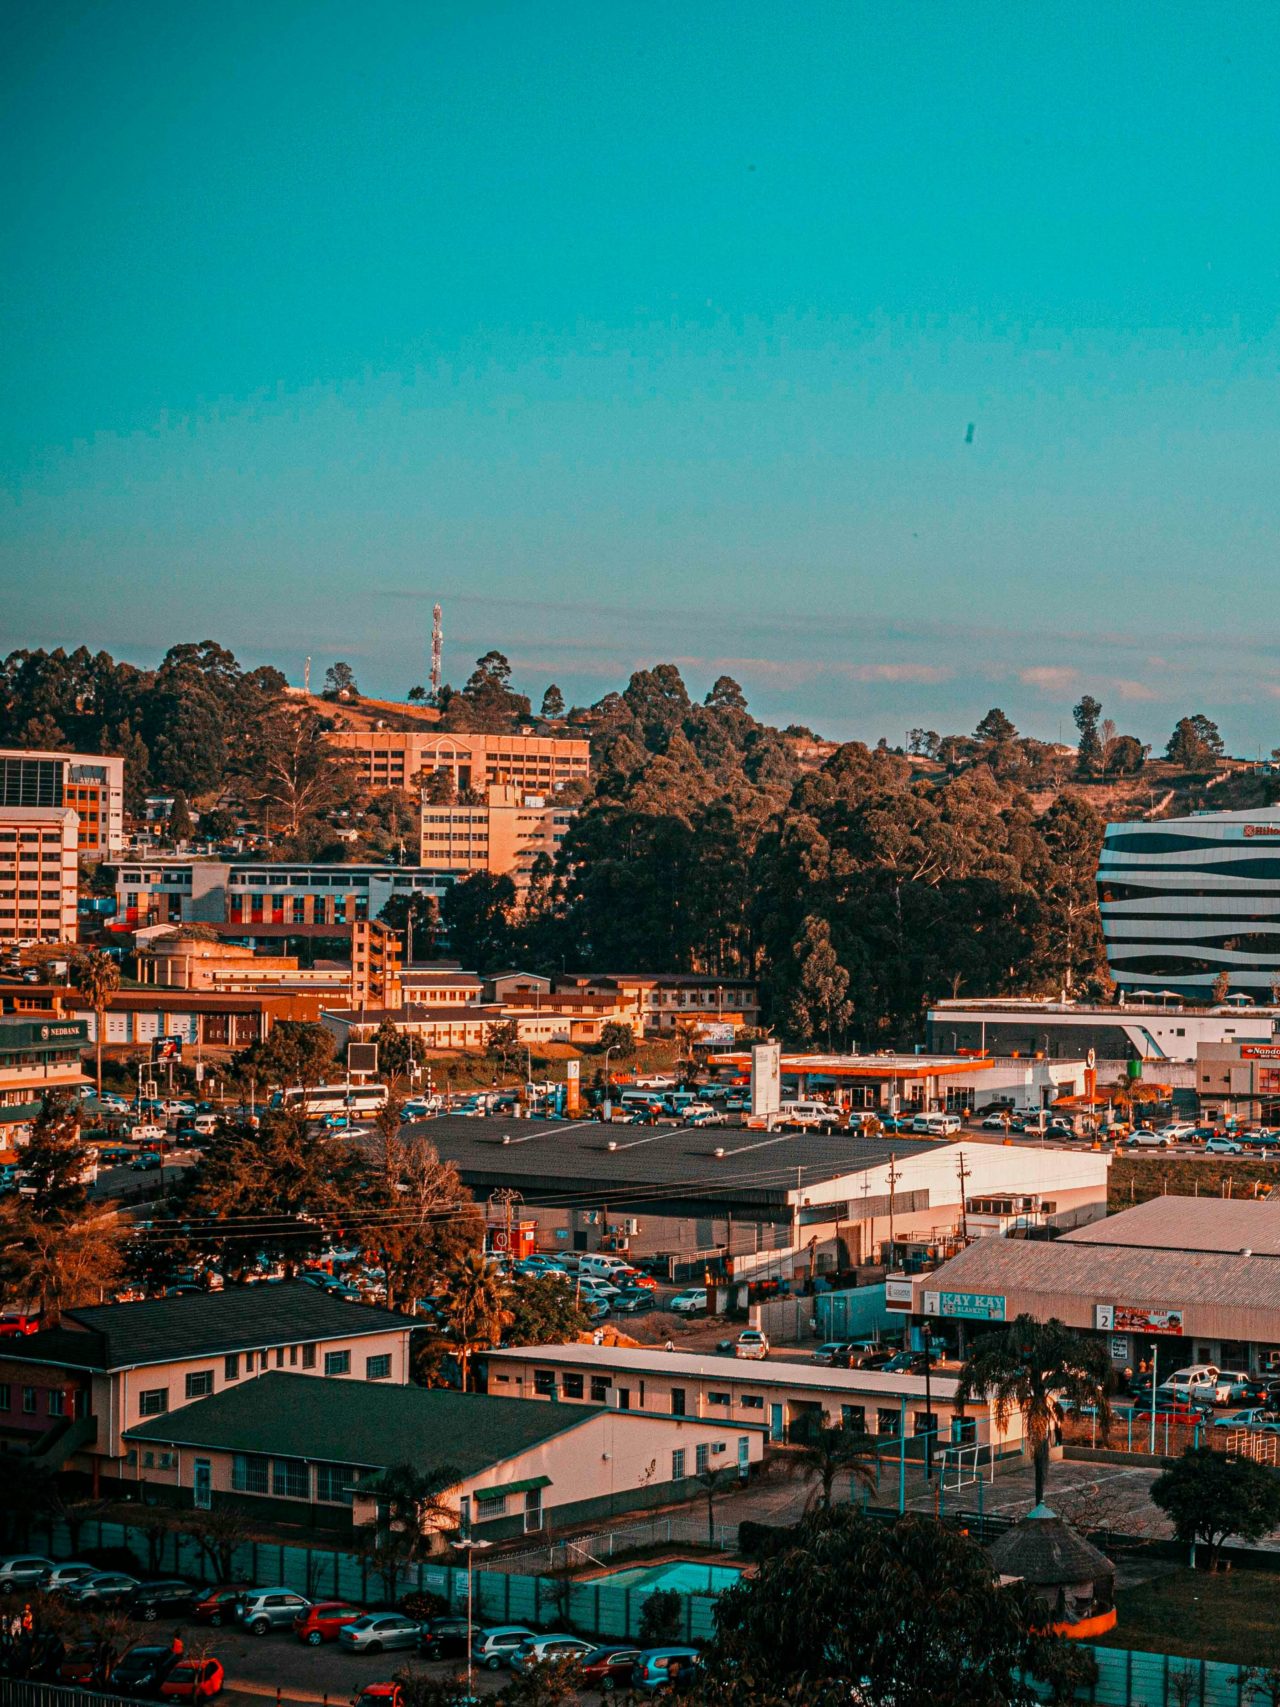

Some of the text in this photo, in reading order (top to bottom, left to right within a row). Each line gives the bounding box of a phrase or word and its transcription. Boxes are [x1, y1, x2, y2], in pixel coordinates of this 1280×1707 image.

[50, 1027, 80, 1036] NEDBANK
[928, 1301, 935, 1313] 1
[942, 1293, 972, 1307] KAY
[974, 1296, 1003, 1309] KAY
[1101, 1315, 1109, 1327] 2
